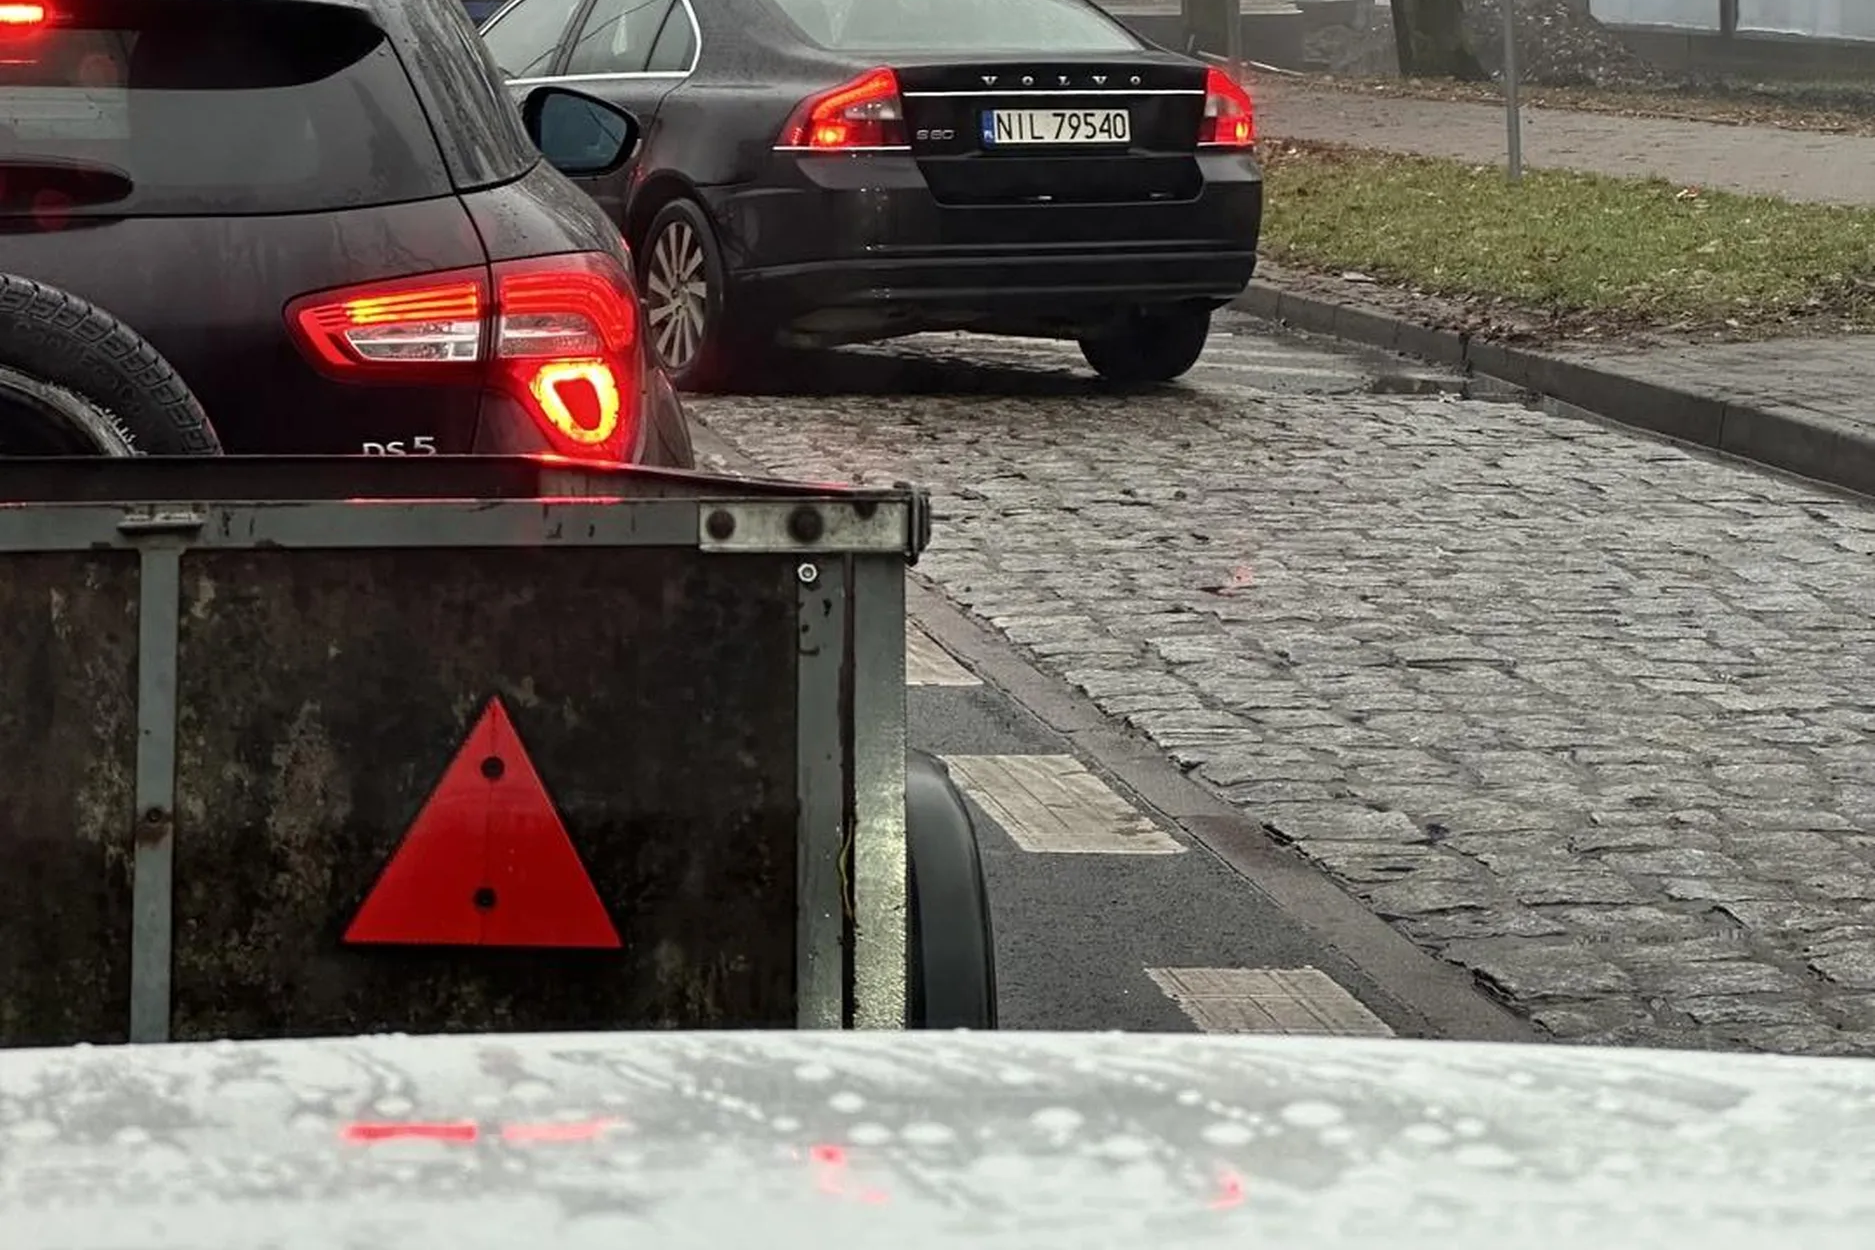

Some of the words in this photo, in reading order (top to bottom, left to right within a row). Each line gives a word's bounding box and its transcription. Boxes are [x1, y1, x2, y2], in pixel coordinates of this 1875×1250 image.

[981, 75, 1141, 86] VOLVO
[996, 112, 1044, 140] NIL
[1052, 112, 1126, 139] 79540
[414, 436, 437, 457] 5
